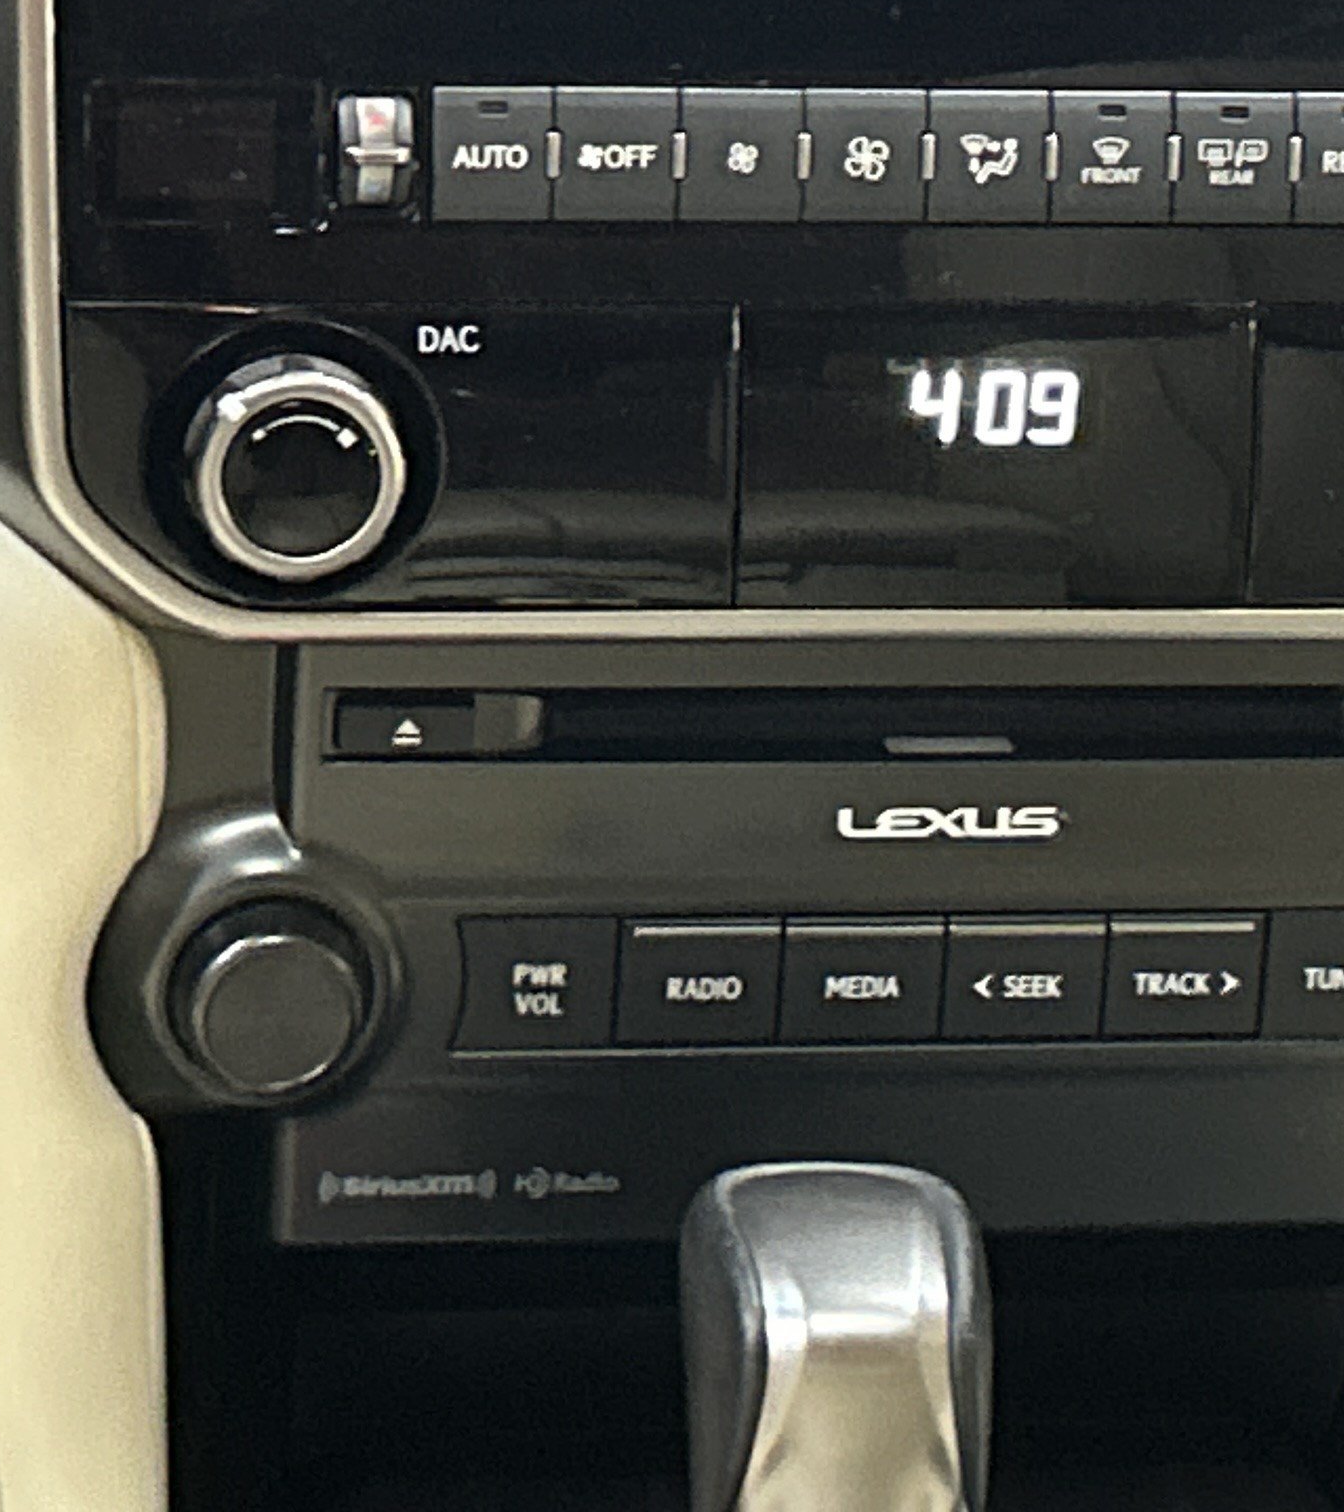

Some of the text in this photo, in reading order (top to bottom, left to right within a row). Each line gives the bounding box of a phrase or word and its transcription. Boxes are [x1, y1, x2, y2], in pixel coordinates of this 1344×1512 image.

[452, 144, 529, 169] AUTO
[603, 144, 658, 169] OFF
[1080, 167, 1142, 185] FRONT
[1209, 169, 1254, 186] REAR
[418, 326, 480, 353] DAC
[837, 806, 1060, 839] LEXUS
[513, 963, 567, 987] PWR
[824, 975, 900, 999] MEDIA
[1003, 975, 1062, 998] SEEK
[1134, 972, 1211, 996] TRACK
[666, 976, 743, 1000] RADIO
[514, 993, 563, 1016] VOL
